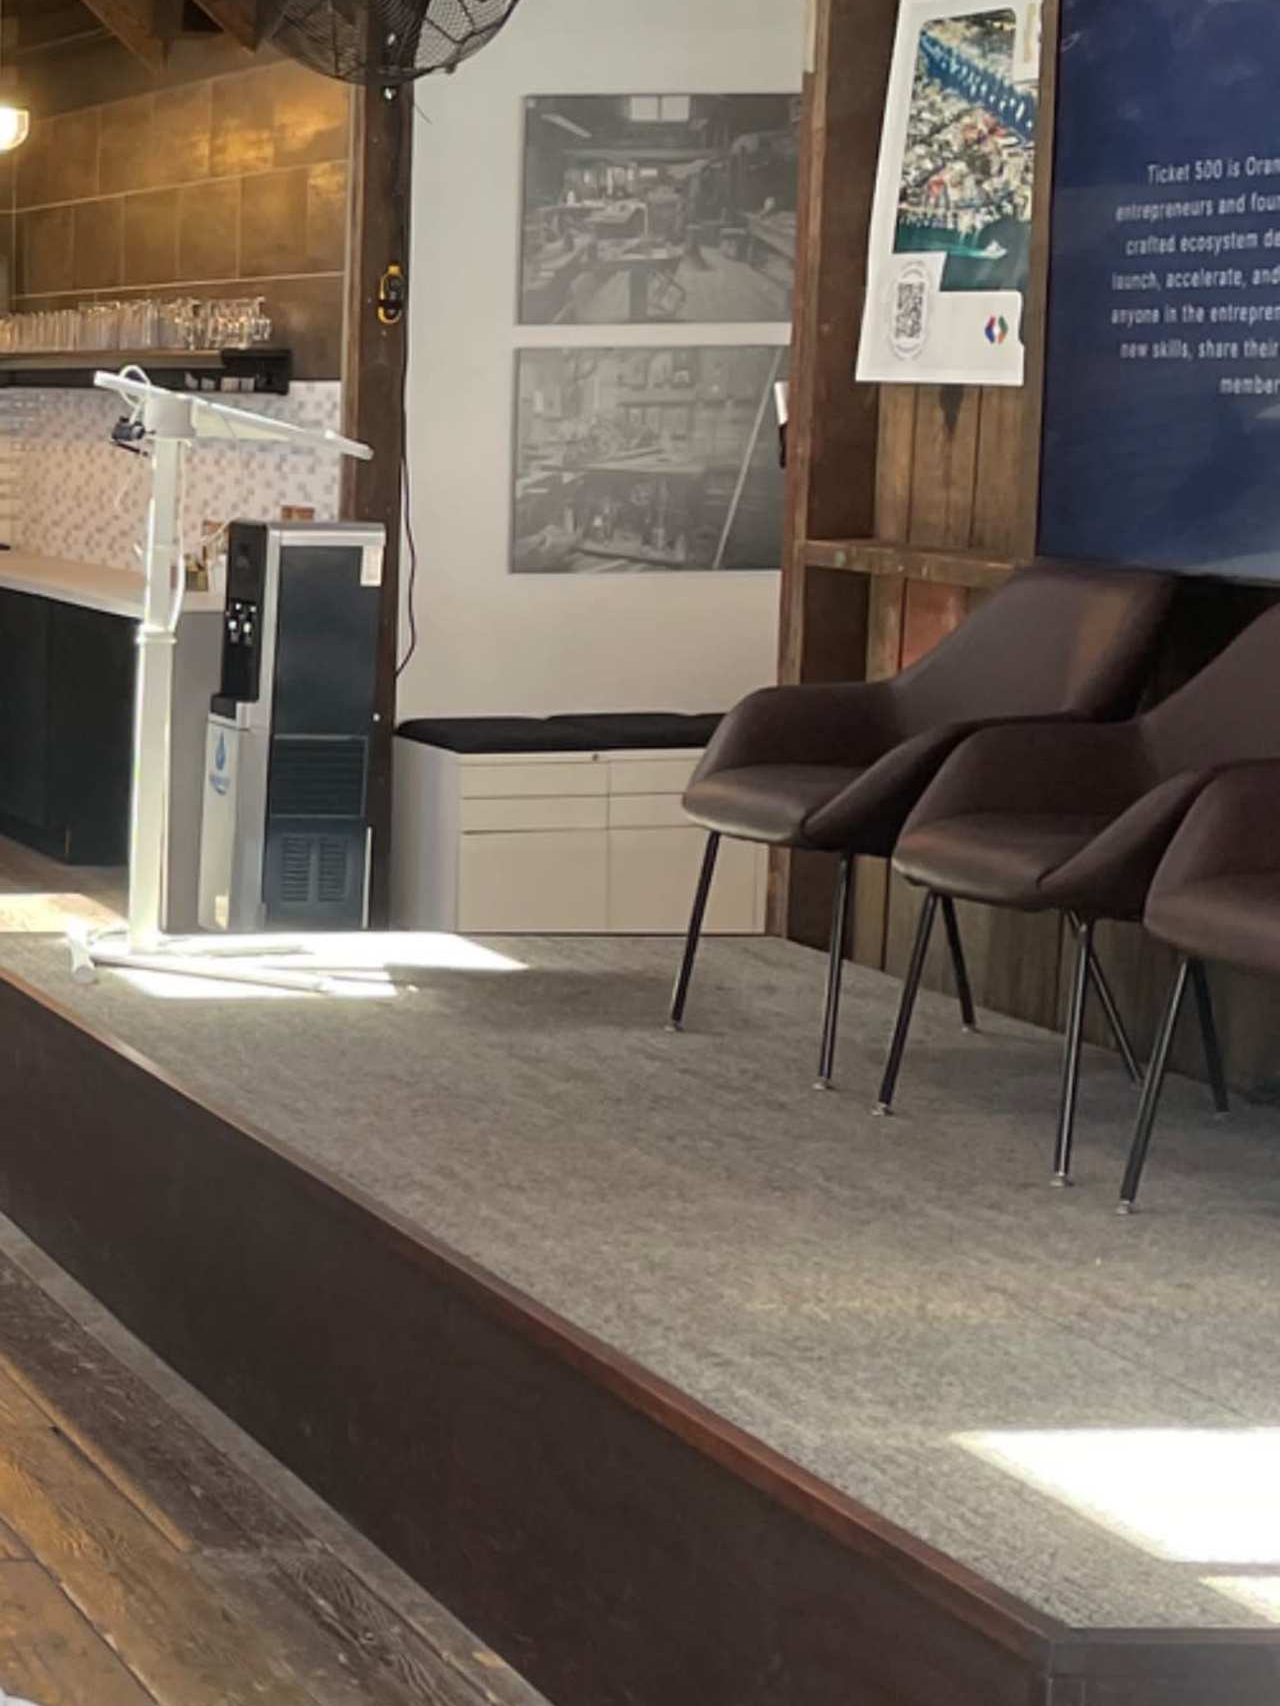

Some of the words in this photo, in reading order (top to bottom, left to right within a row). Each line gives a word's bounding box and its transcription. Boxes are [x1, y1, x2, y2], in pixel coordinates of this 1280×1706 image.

[1147, 163, 1190, 184] Ticket
[1195, 159, 1222, 180] 500
[1227, 159, 1240, 178] is
[1116, 198, 1213, 222] entrepreneurs
[1218, 195, 1245, 214] and
[1126, 235, 1176, 256] crafted
[1180, 232, 1258, 256] ecosystem
[1112, 272, 1161, 291] launch,
[1166, 268, 1246, 288] accelerate,
[1252, 266, 1280, 285] and
[1111, 308, 1160, 327] anyone
[1164, 305, 1177, 323] in
[1182, 304, 1205, 323] the
[1120, 343, 1148, 358] new
[1152, 341, 1193, 361] skills,
[1198, 341, 1238, 358] share
[1243, 340, 1280, 358] their
